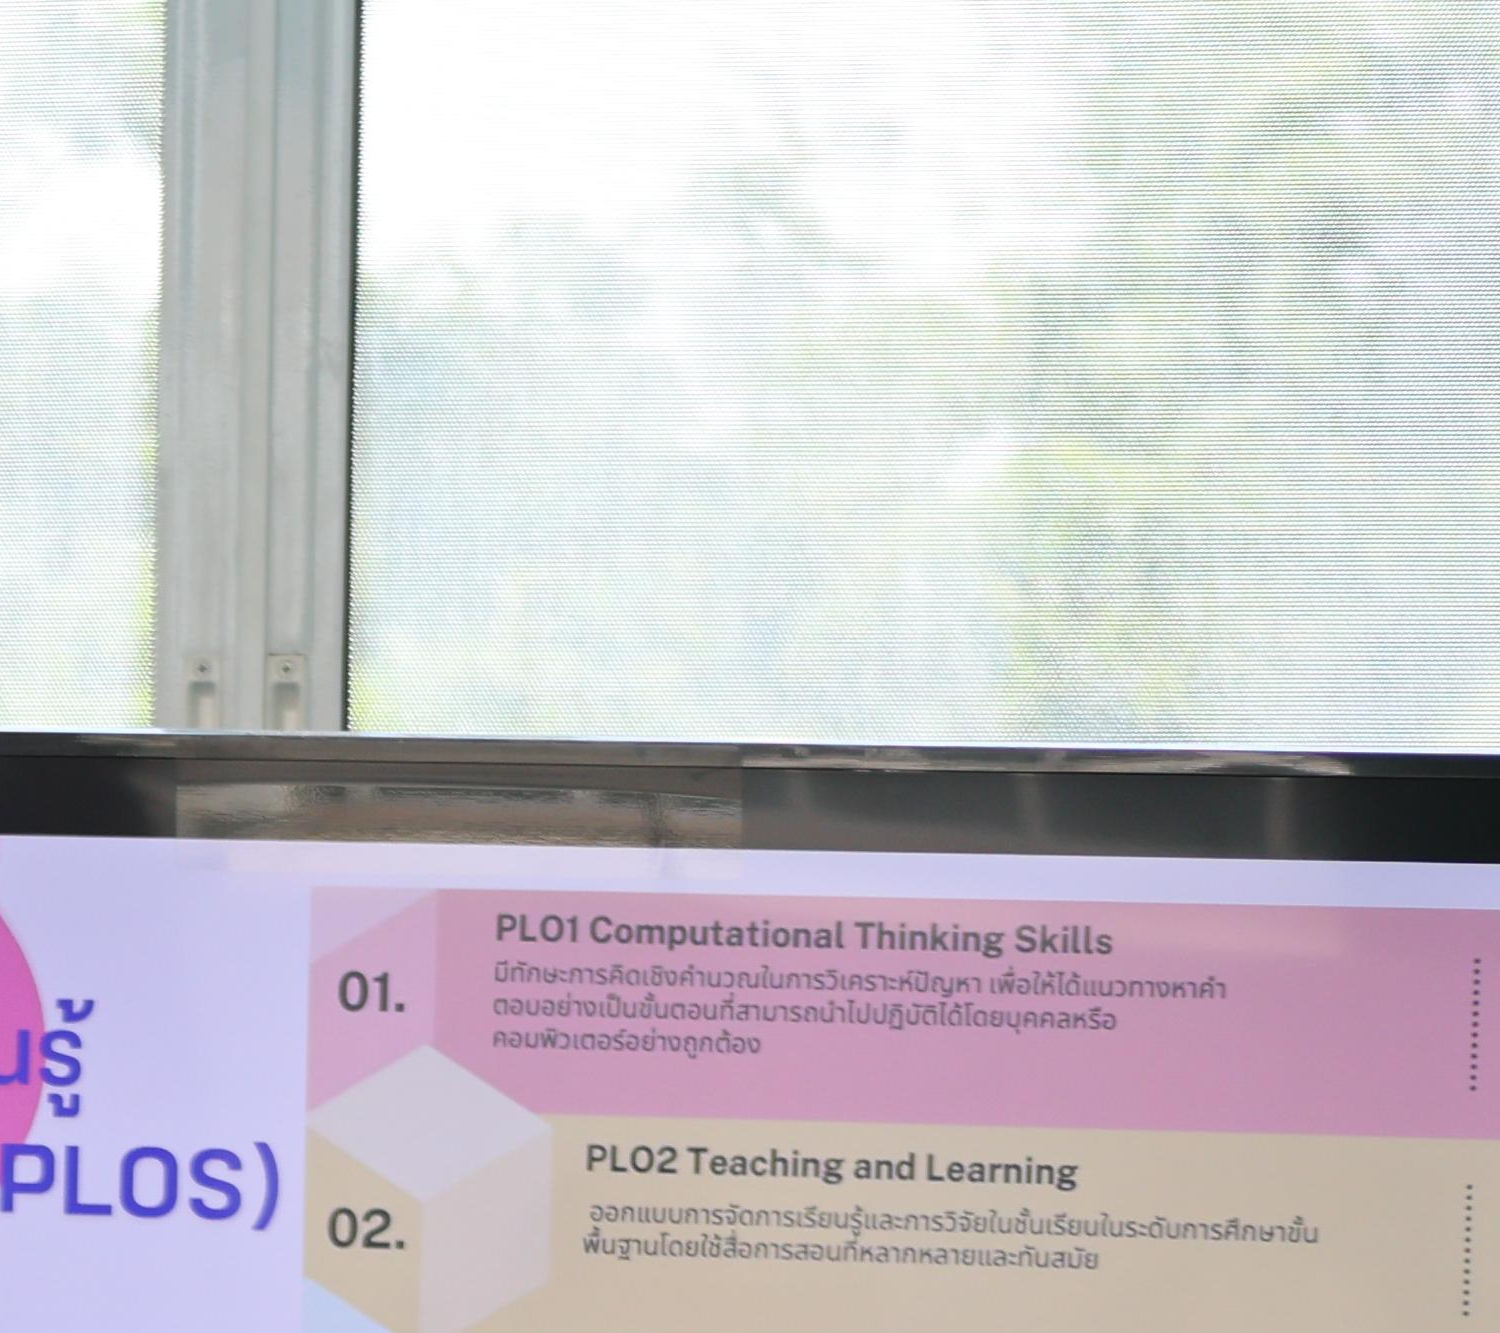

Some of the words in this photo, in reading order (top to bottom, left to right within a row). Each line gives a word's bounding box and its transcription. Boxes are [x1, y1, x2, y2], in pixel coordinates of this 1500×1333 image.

[497, 914, 577, 942] PLO1
[590, 915, 844, 951] Computational
[854, 922, 1005, 959] Thinking
[1015, 925, 1113, 955] Skills
[339, 971, 405, 1012] 01.
[493, 1027, 761, 1059] คอมพิวเตอร์อย่างถูกต้อง
[587, 1144, 677, 1174] PLO2
[686, 1147, 845, 1185] Teaching
[854, 1152, 915, 1180] and
[927, 1154, 1078, 1192] Learning
[328, 1207, 405, 1249] 02.
